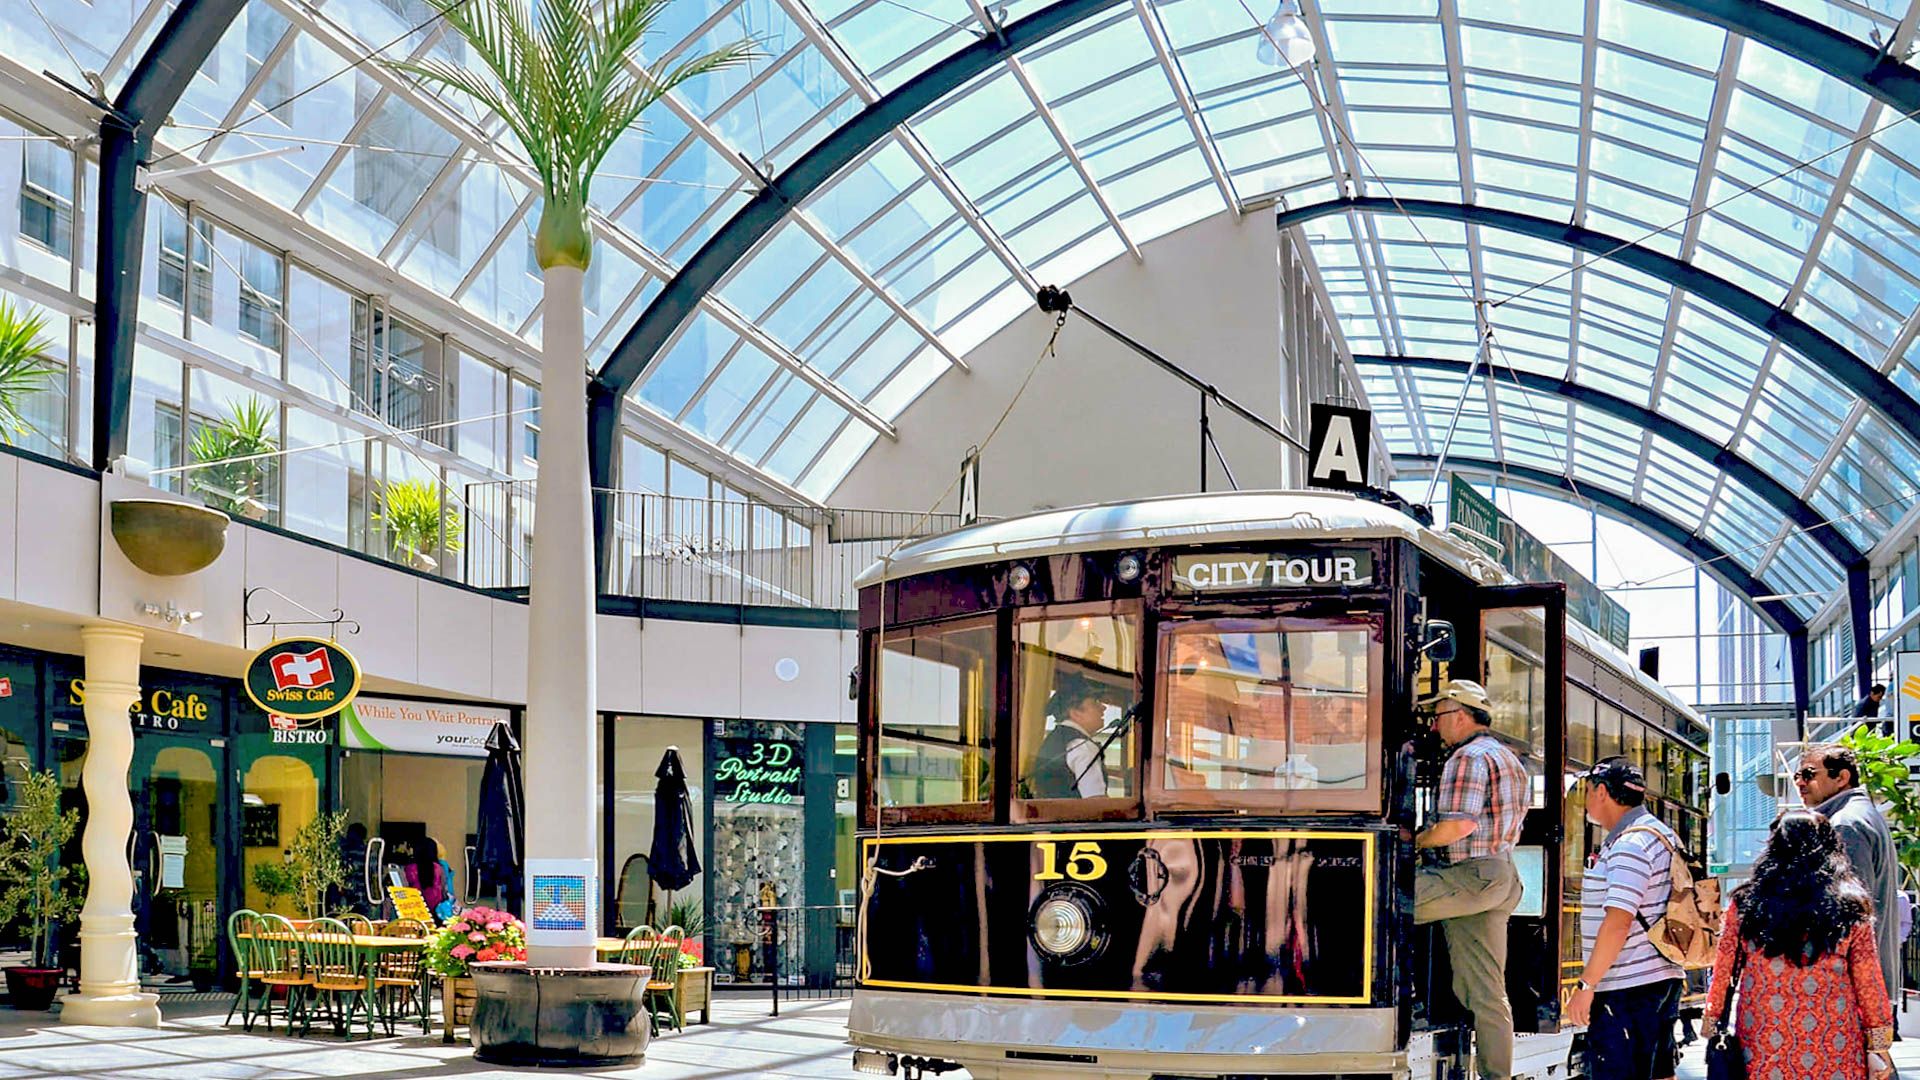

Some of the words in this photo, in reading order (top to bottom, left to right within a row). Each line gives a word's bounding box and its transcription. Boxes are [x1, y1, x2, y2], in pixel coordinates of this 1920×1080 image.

[1313, 415, 1363, 483] A
[961, 461, 977, 527] A
[1187, 560, 1260, 587] CITY
[1266, 557, 1357, 583] TOUR
[151, 690, 208, 720] Cafe
[266, 689, 303, 701] Swiss
[306, 688, 335, 701] Cafe
[357, 704, 395, 720] While
[400, 707, 422, 721] You
[426, 709, 455, 723] Wait
[273, 729, 327, 743] BISTRO
[746, 743, 793, 766] 3D
[715, 757, 800, 783] Portrait
[725, 781, 792, 804] Studio
[1034, 842, 1108, 881] 15
